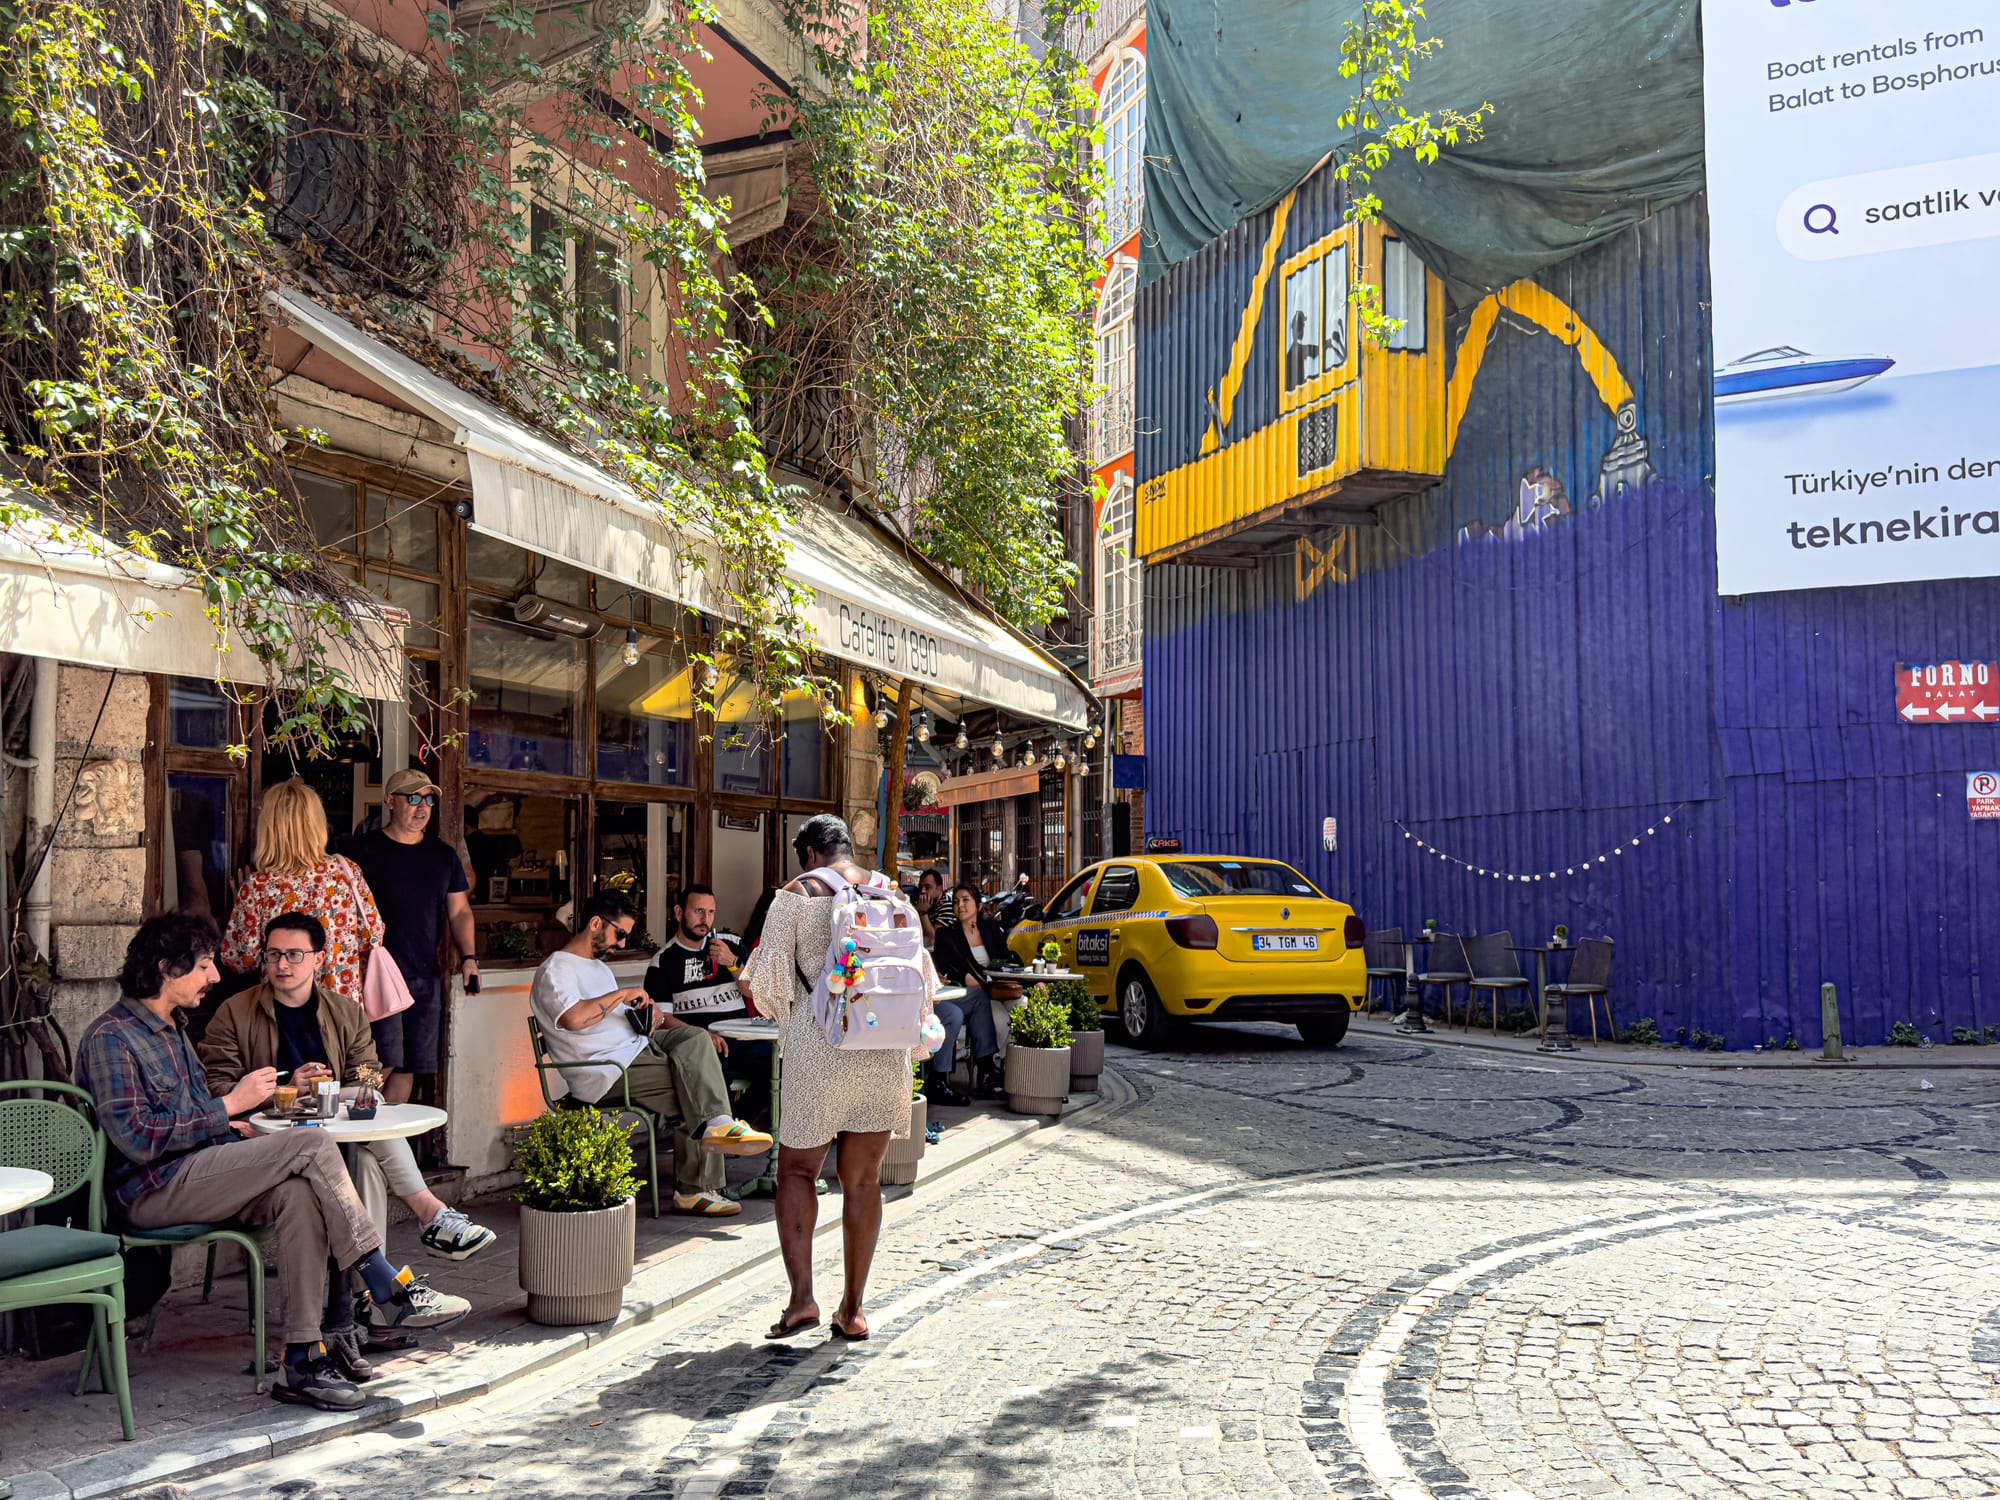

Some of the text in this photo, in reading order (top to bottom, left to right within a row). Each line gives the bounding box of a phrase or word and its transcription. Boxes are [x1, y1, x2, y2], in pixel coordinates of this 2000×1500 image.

[1767, 29, 1983, 80] Boat rentals from
[1769, 85, 1834, 112] Balat
[1840, 82, 1866, 99] to
[1865, 189, 2000, 223] saatlik v
[1784, 463, 1939, 495] Türkiye'nin
[1786, 506, 2000, 549] teknekira
[839, 604, 938, 677] Cafelife 1890
[1911, 663, 1989, 687] FORNO
[1925, 690, 1976, 698] BALAT
[1078, 934, 1107, 951] bitaksi
[1259, 937, 1315, 948] 34 TGM 46
